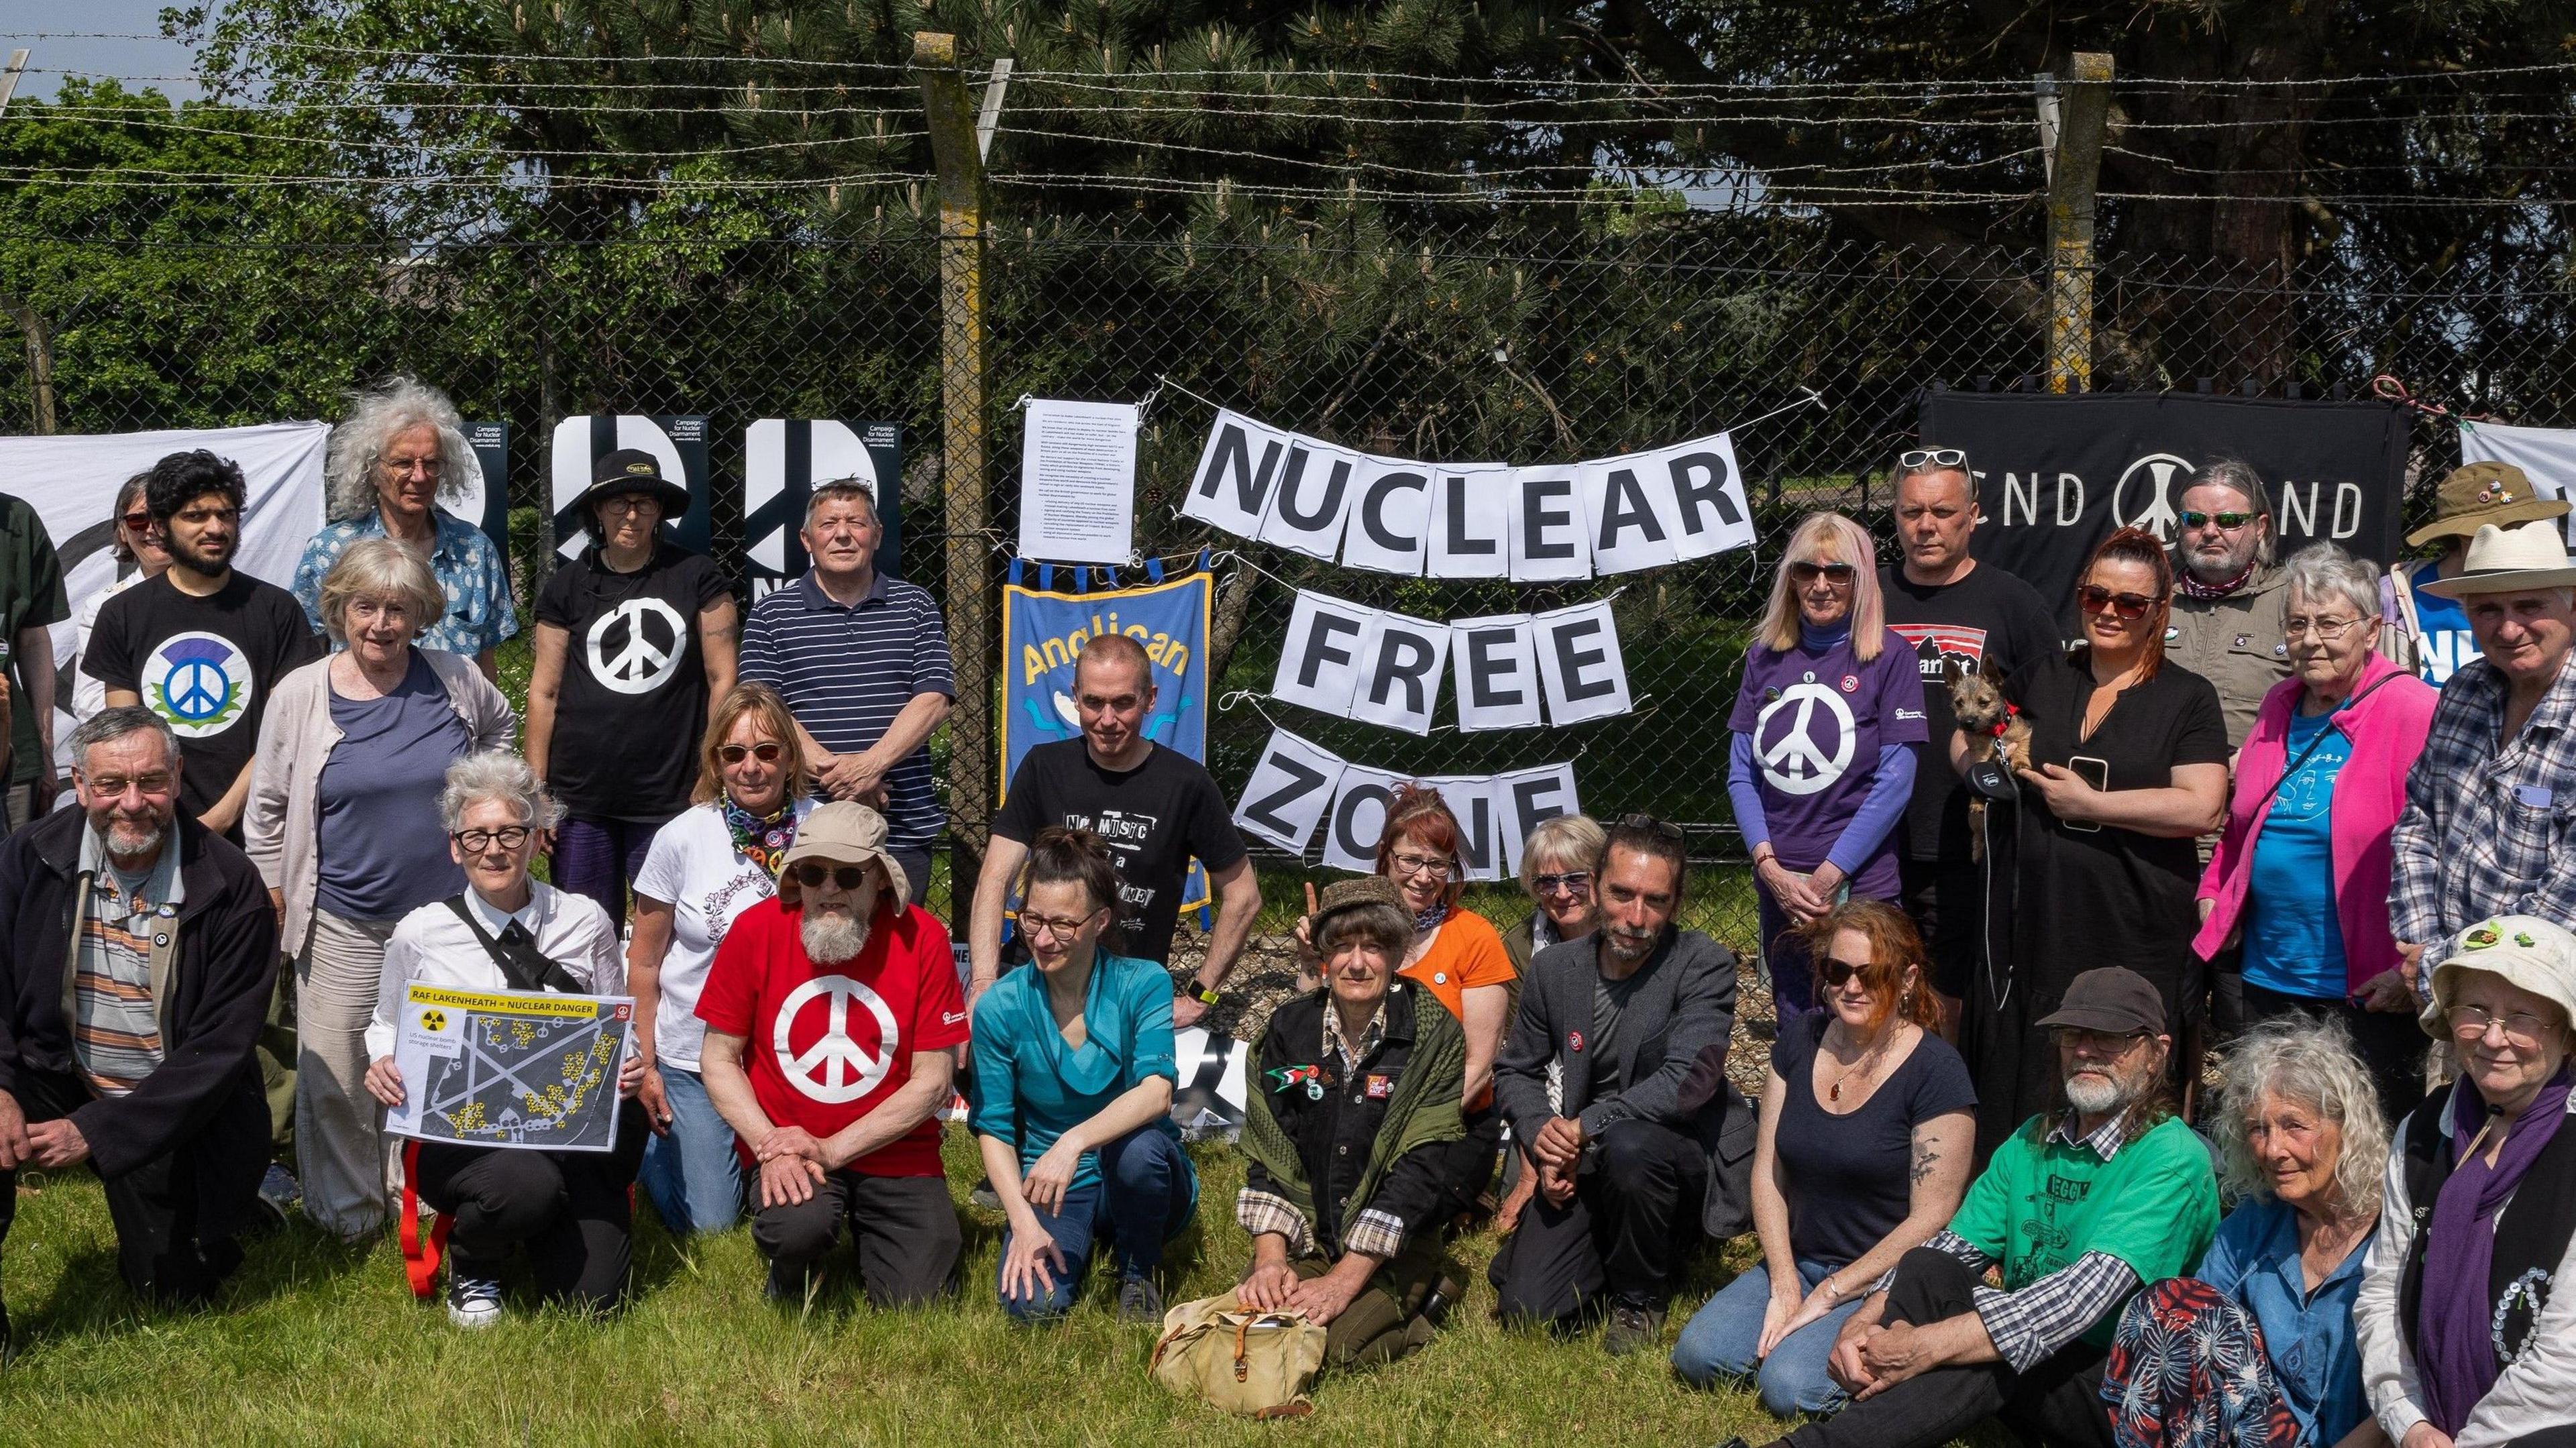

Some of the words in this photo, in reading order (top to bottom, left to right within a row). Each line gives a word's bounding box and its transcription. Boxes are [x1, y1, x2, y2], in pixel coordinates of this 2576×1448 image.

[1199, 424, 1743, 559] NUCLEAR
[2279, 480, 2363, 539] ND
[1297, 611, 1615, 716] FREE
[1116, 881, 1156, 908] ANET
[413, 990, 431, 999] RAF
[433, 992, 497, 1007] LAKENHEATH
[507, 1001, 551, 1011] NUCLEAR
[553, 1003, 594, 1013] DANGER
[409, 1039, 429, 1047] storage
[430, 1042, 452, 1050] shelters
